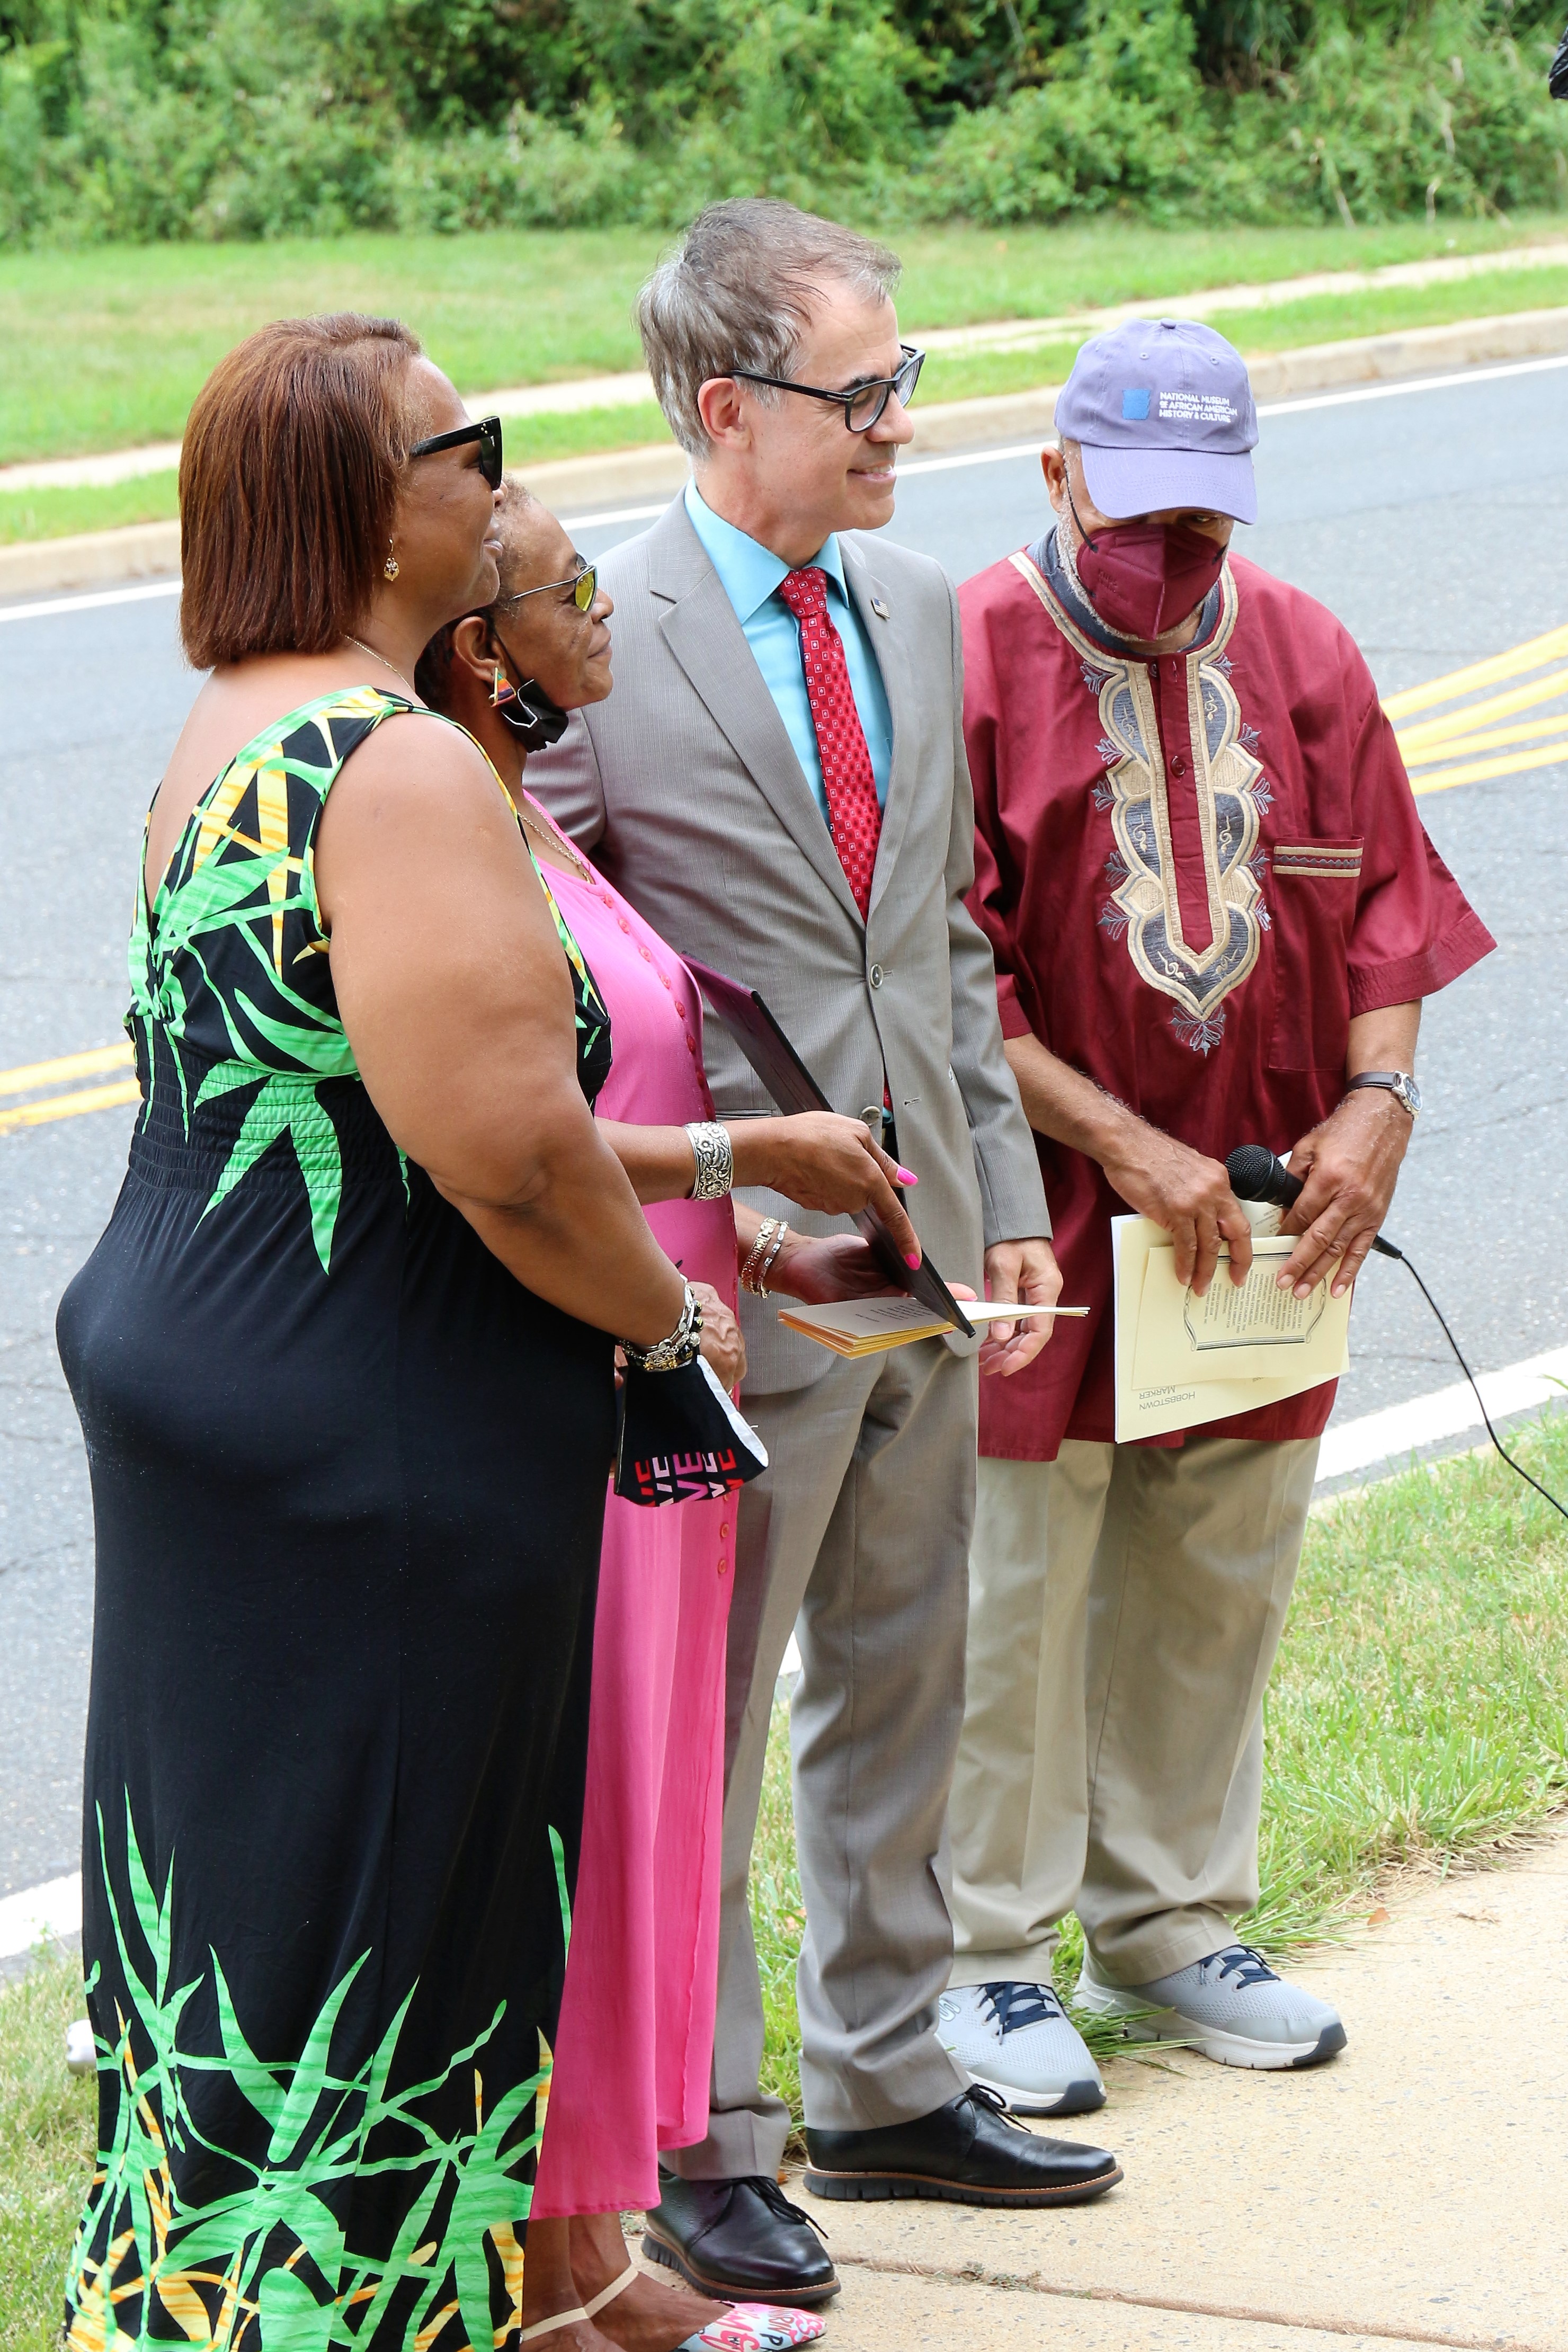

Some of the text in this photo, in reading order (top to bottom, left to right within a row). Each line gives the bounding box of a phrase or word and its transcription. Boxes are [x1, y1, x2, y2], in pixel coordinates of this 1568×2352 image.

[1160, 391, 1230, 406] NATIONAL MUSEUM
[1159, 409, 1194, 420] HISTORY
[1200, 413, 1231, 423] CULTURE
[1169, 402, 1204, 413] AFRICAN
[1203, 404, 1238, 416] AMERICAN
[1139, 1385, 1175, 1400] MARKER
[1139, 1391, 1196, 1411] HOBBSTOWN
